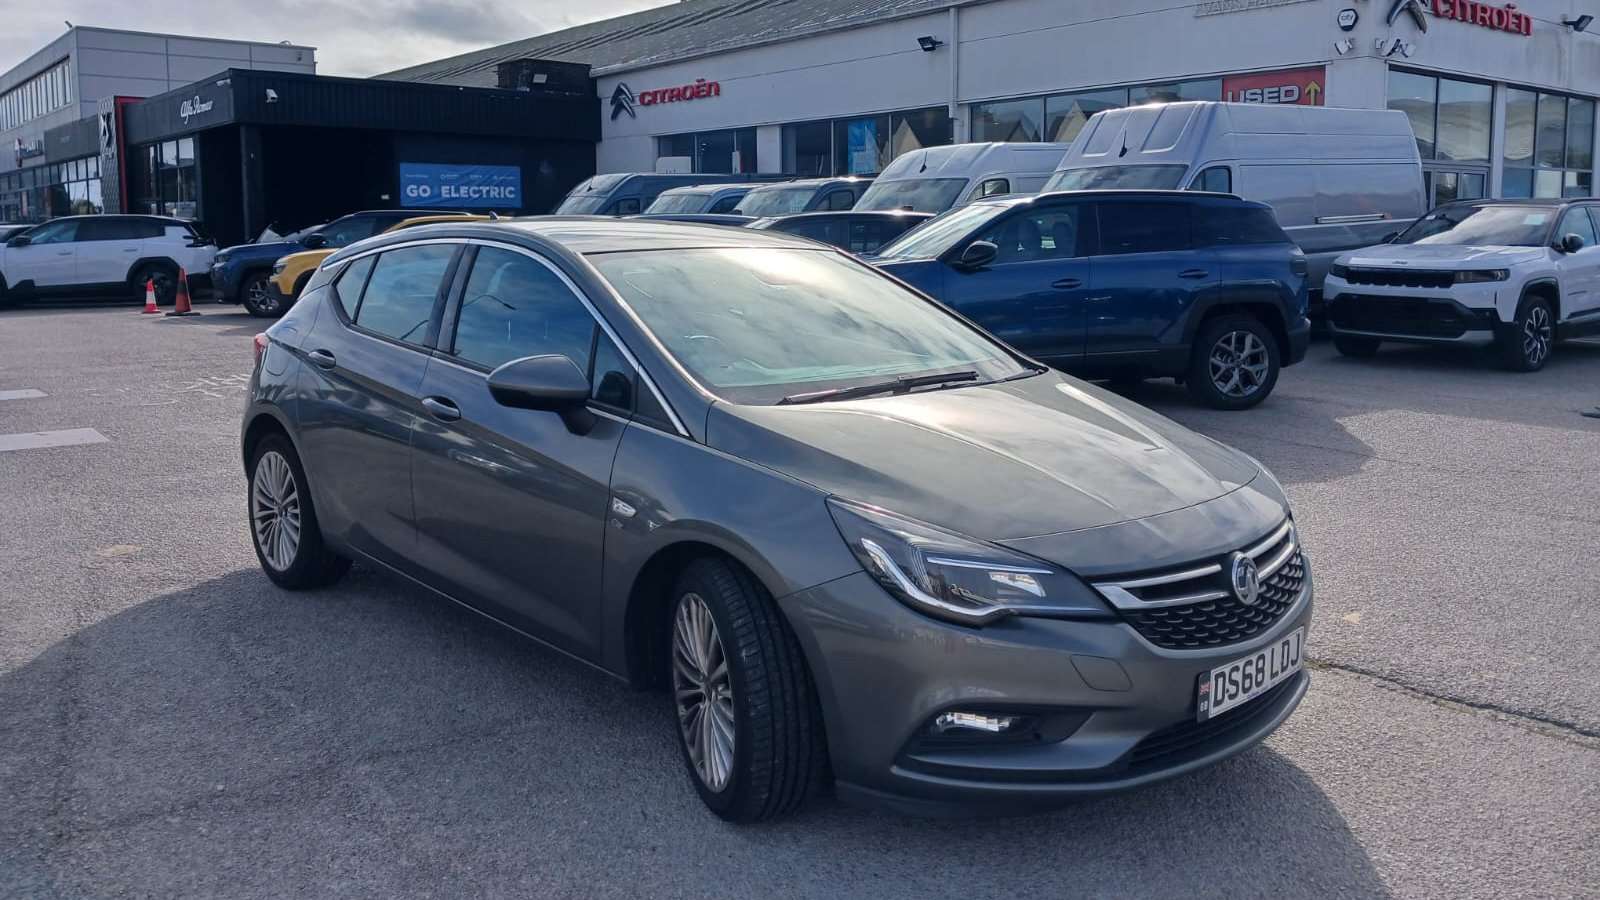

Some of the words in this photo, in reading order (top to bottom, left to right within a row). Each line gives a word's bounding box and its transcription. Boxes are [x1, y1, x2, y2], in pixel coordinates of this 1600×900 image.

[1227, 85, 1299, 104] USED
[406, 184, 432, 198] GO
[441, 185, 516, 199] ELECTRIC
[1214, 654, 1266, 708] DS68
[1270, 633, 1300, 681] LDJ
